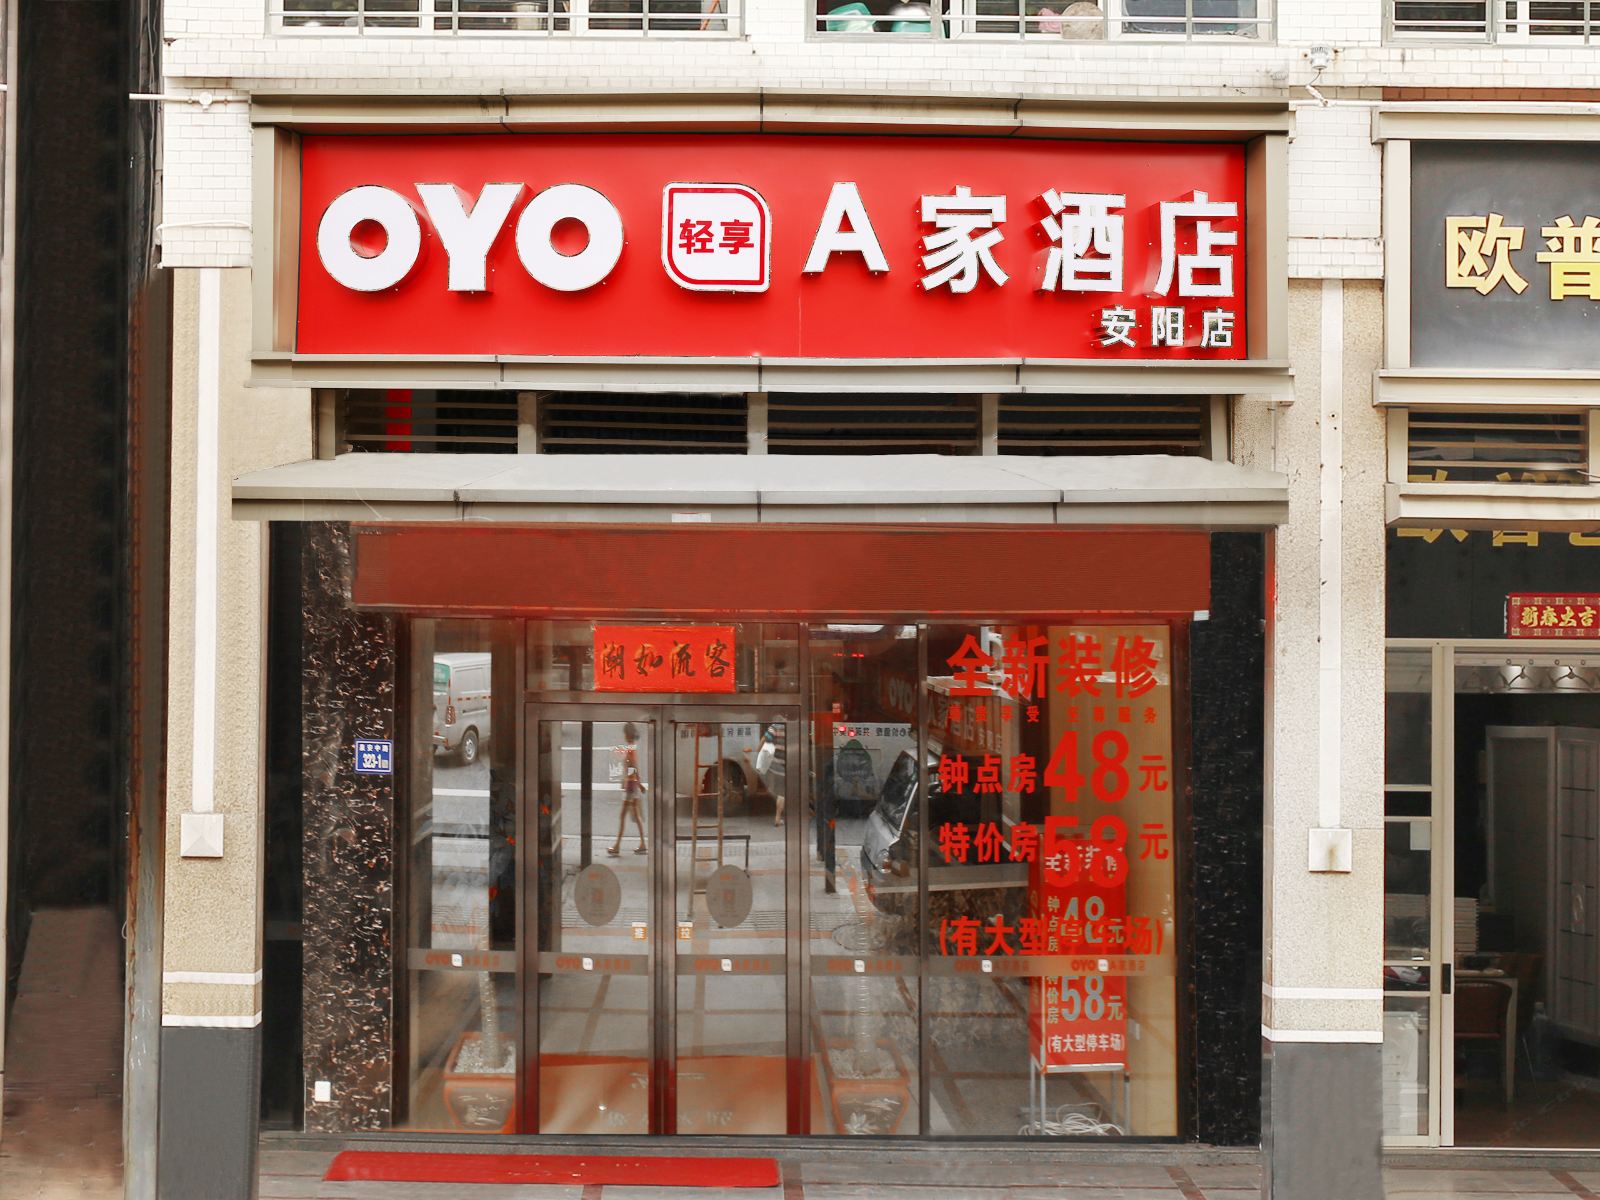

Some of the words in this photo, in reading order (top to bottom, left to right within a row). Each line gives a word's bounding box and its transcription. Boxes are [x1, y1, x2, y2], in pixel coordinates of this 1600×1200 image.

[317, 183, 624, 292] OYO
[678, 219, 754, 253] 轻享
[1446, 212, 1600, 300] 欧普
[1100, 305, 1235, 348] 安阳店
[946, 634, 1159, 699] 全新装修
